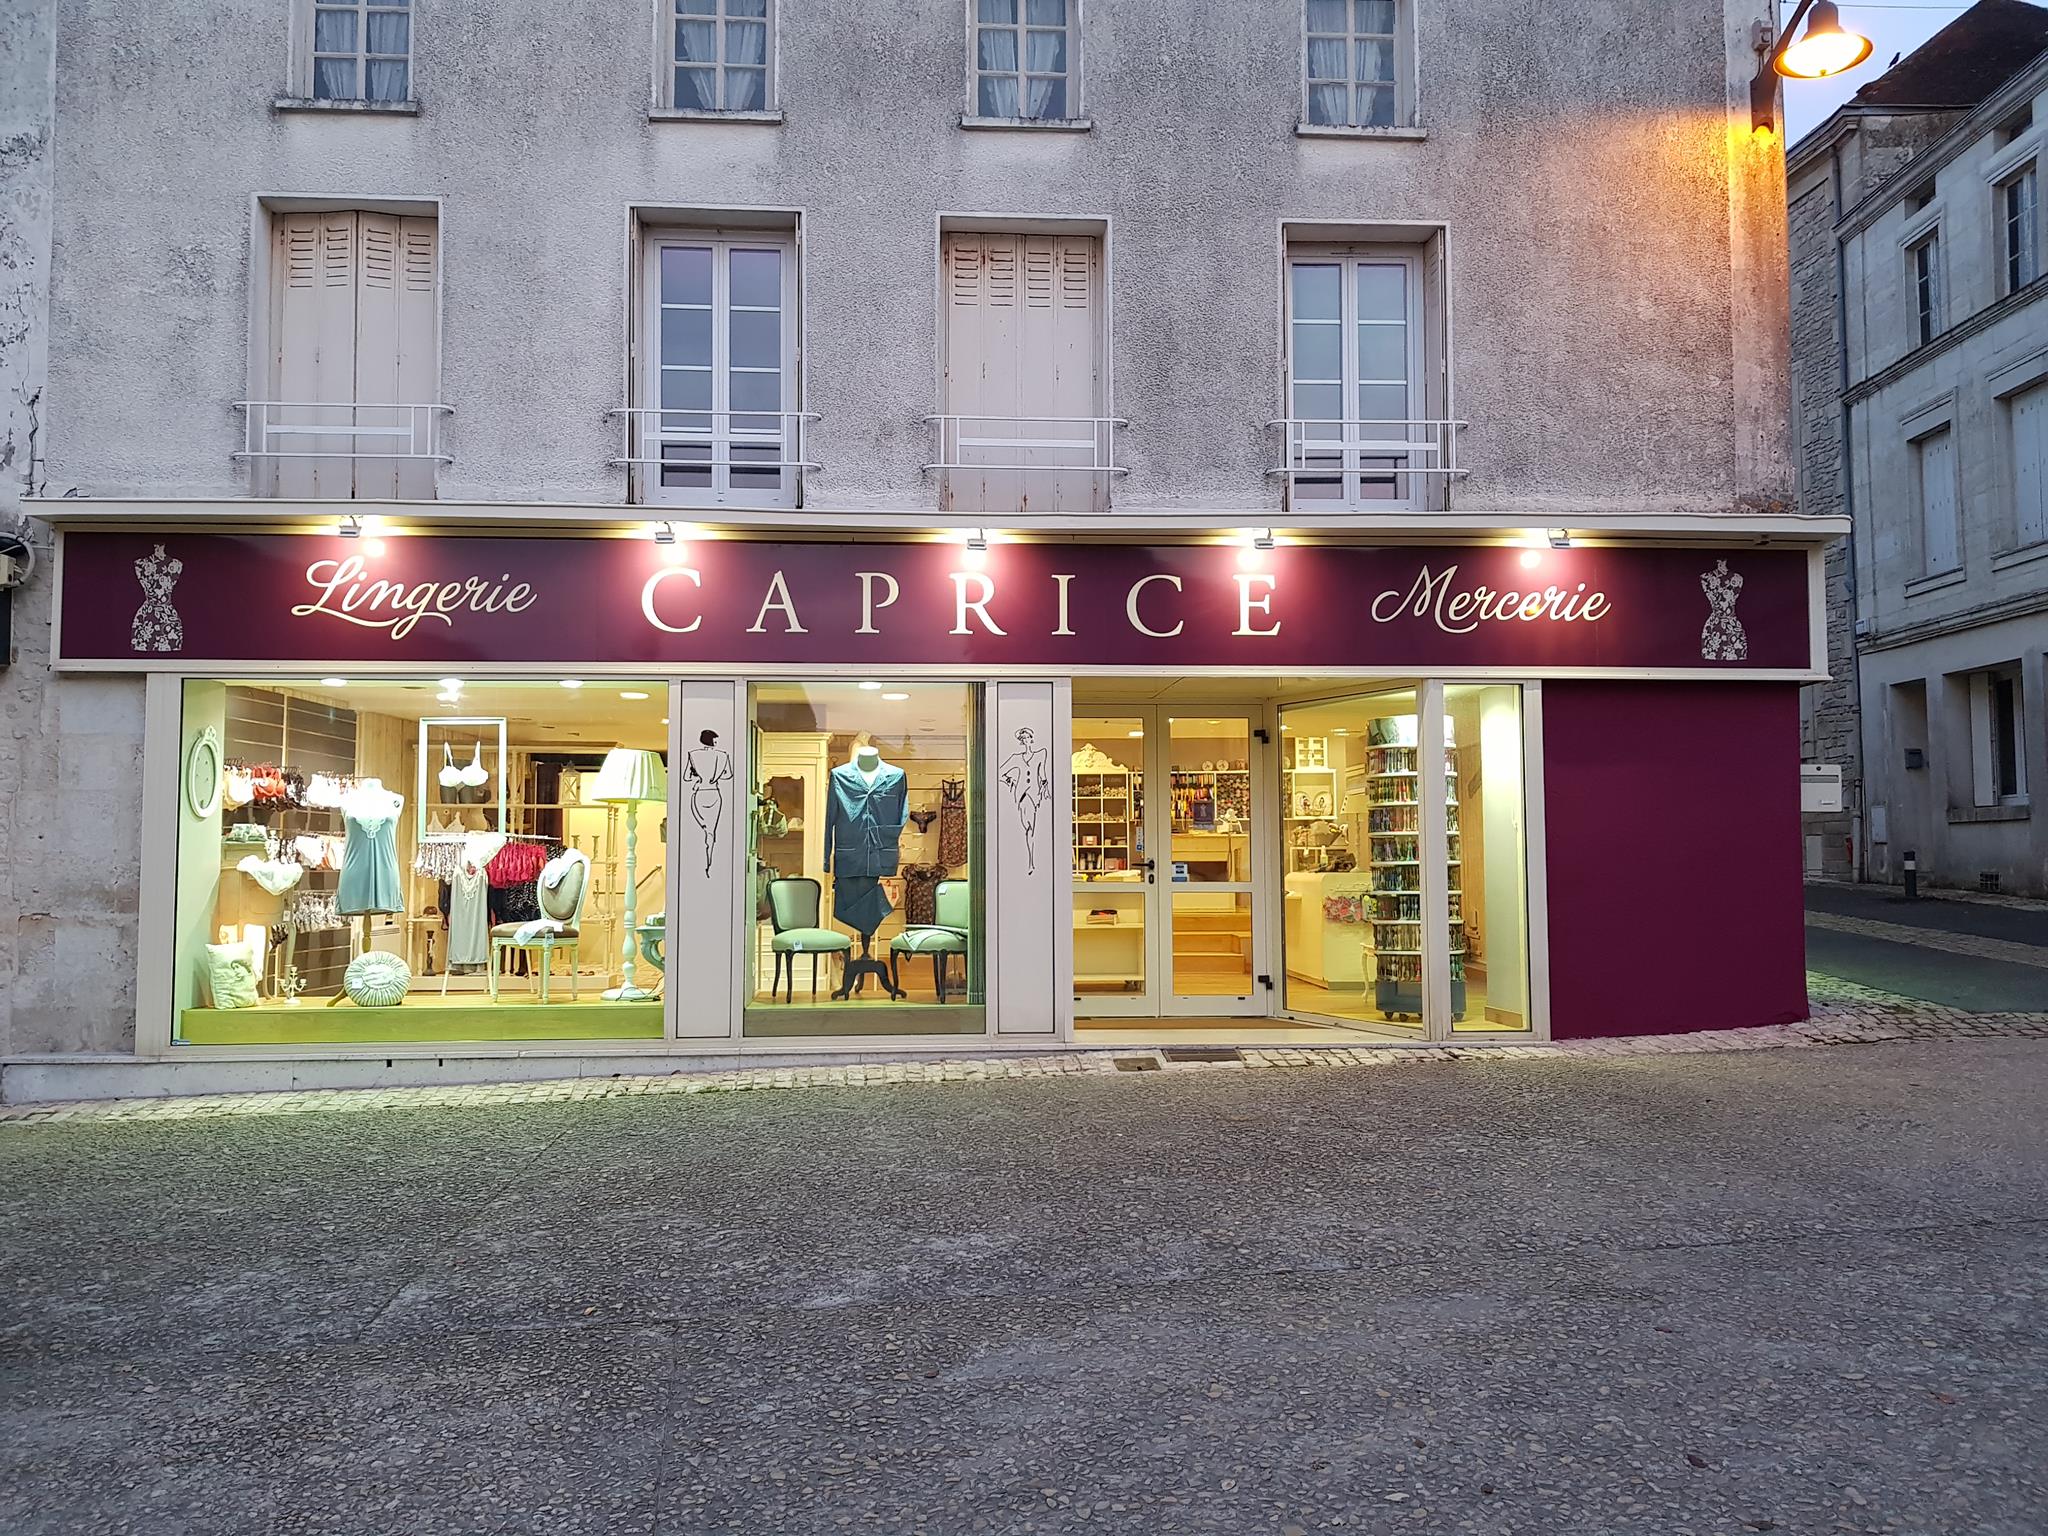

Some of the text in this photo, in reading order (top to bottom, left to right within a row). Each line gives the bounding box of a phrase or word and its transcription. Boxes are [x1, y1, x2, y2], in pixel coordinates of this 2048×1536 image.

[291, 555, 1612, 640] Lingerie CAPRICE Mercerie
